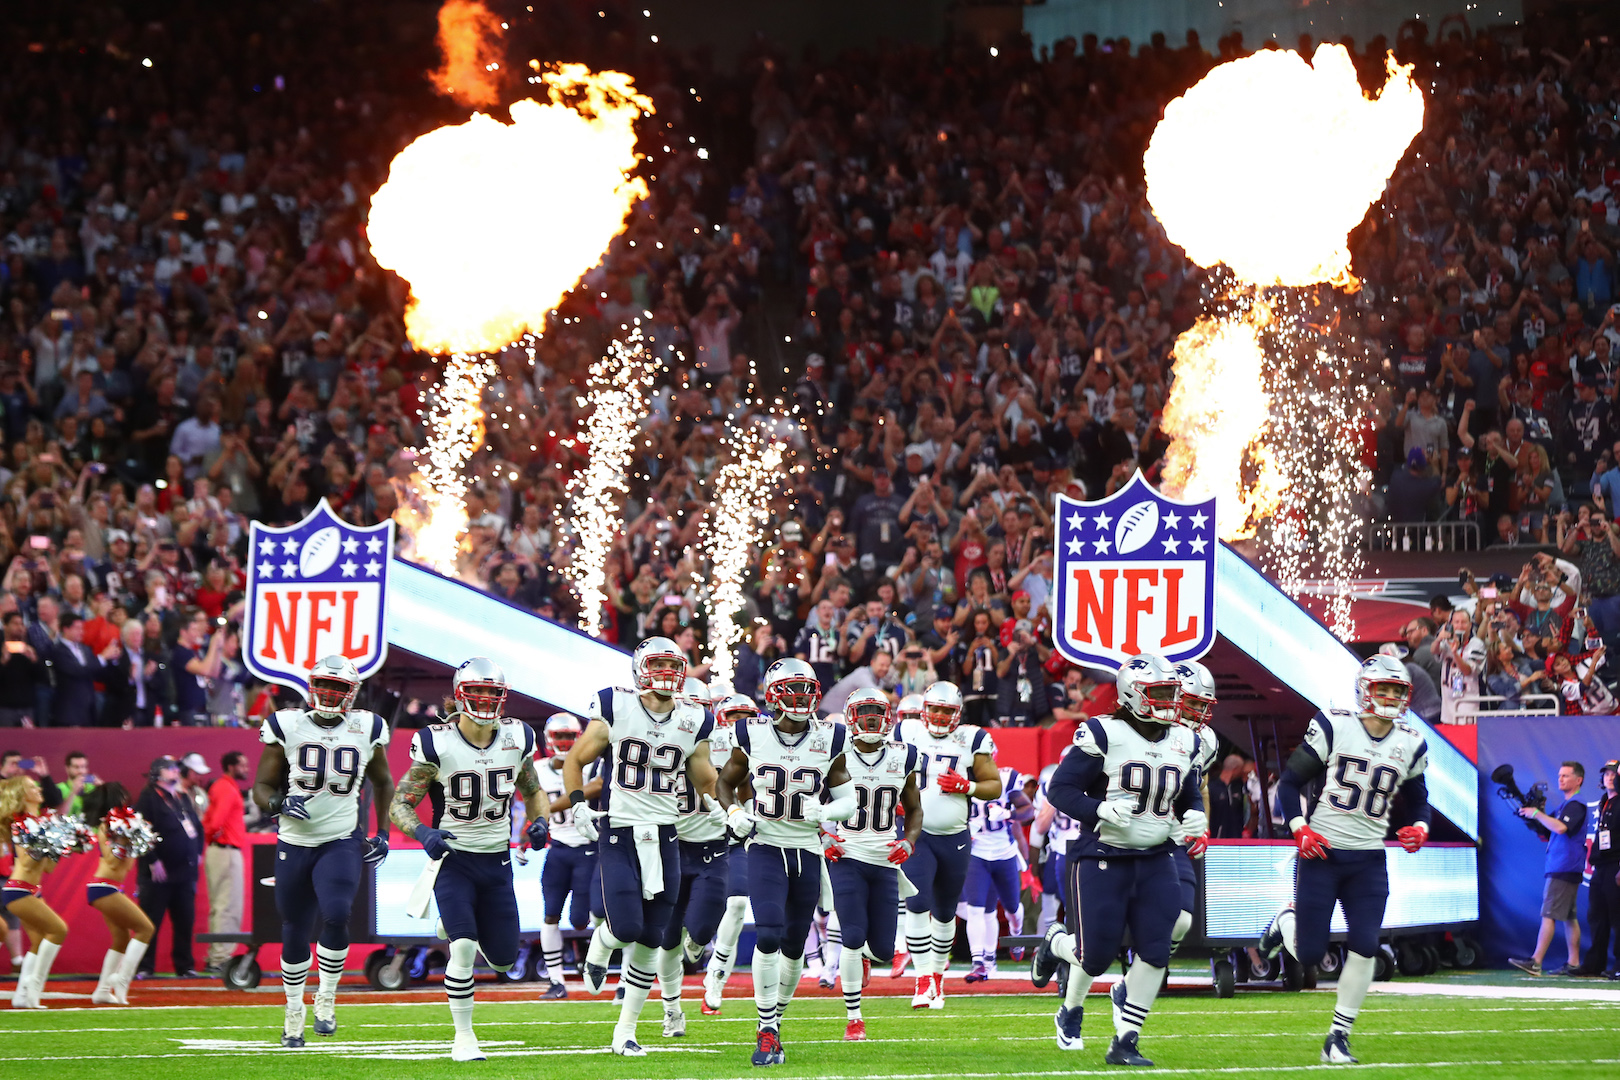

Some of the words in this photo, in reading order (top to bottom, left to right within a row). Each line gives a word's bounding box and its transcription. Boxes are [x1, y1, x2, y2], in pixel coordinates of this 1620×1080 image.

[260, 591, 369, 670] NFL
[1071, 568, 1197, 656] NFL
[809, 637, 838, 663] 12
[294, 742, 360, 797] 99
[448, 766, 515, 823] 95
[614, 736, 684, 795] 82
[755, 763, 823, 822] 32
[1118, 760, 1182, 819] 90
[1326, 753, 1402, 820] 58
